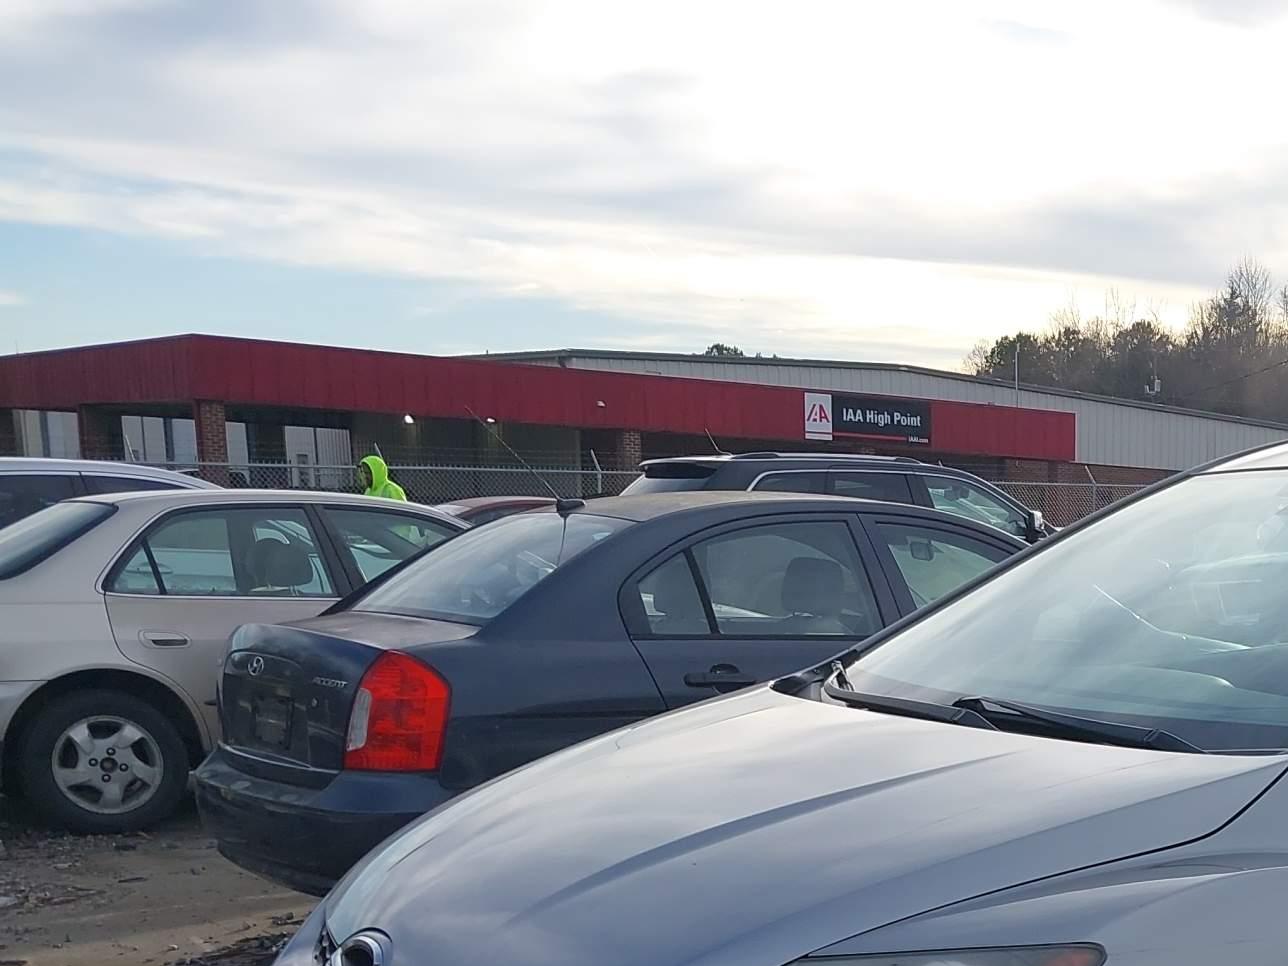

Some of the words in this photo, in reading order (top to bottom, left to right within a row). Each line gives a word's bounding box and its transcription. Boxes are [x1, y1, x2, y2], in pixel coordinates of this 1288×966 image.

[843, 408, 863, 422] IAA
[866, 409, 891, 427] High
[893, 412, 921, 427] Point
